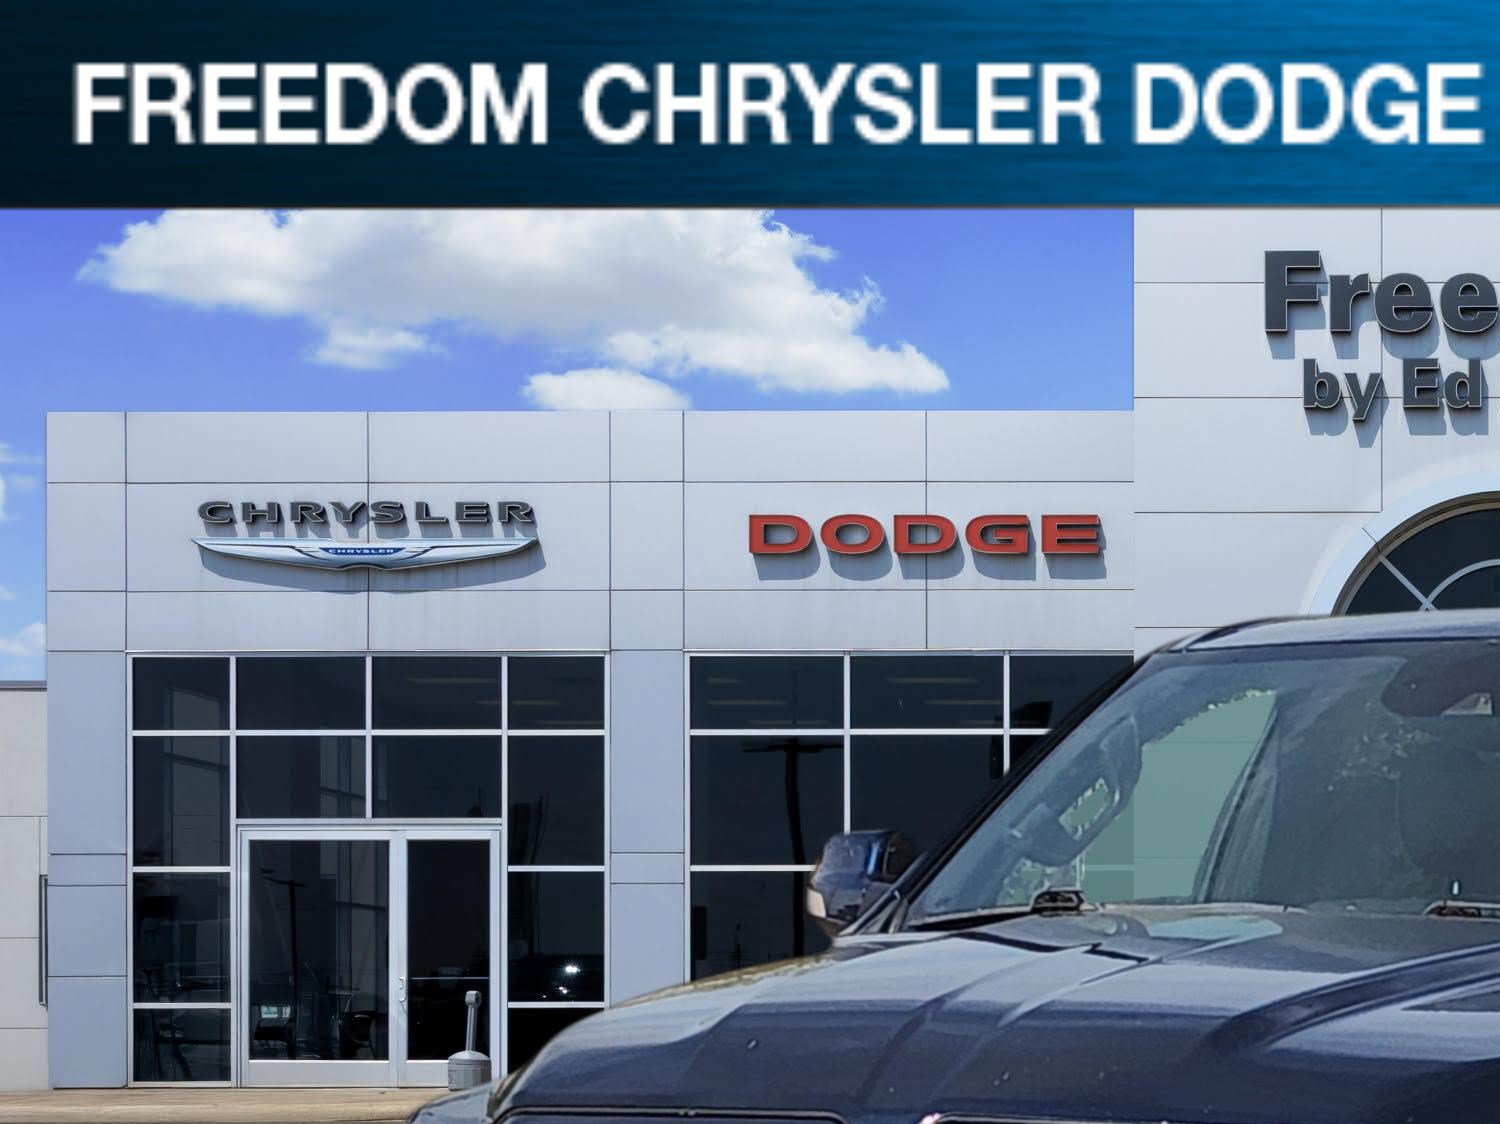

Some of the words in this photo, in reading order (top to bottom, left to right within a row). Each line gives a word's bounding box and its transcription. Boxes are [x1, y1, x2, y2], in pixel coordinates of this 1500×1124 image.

[1303, 357, 1383, 422] by
[1402, 357, 1483, 409] Ed
[197, 501, 535, 524] CHRYSLER
[749, 513, 1100, 554] DODGE
[327, 547, 396, 555] CHRYSLER
